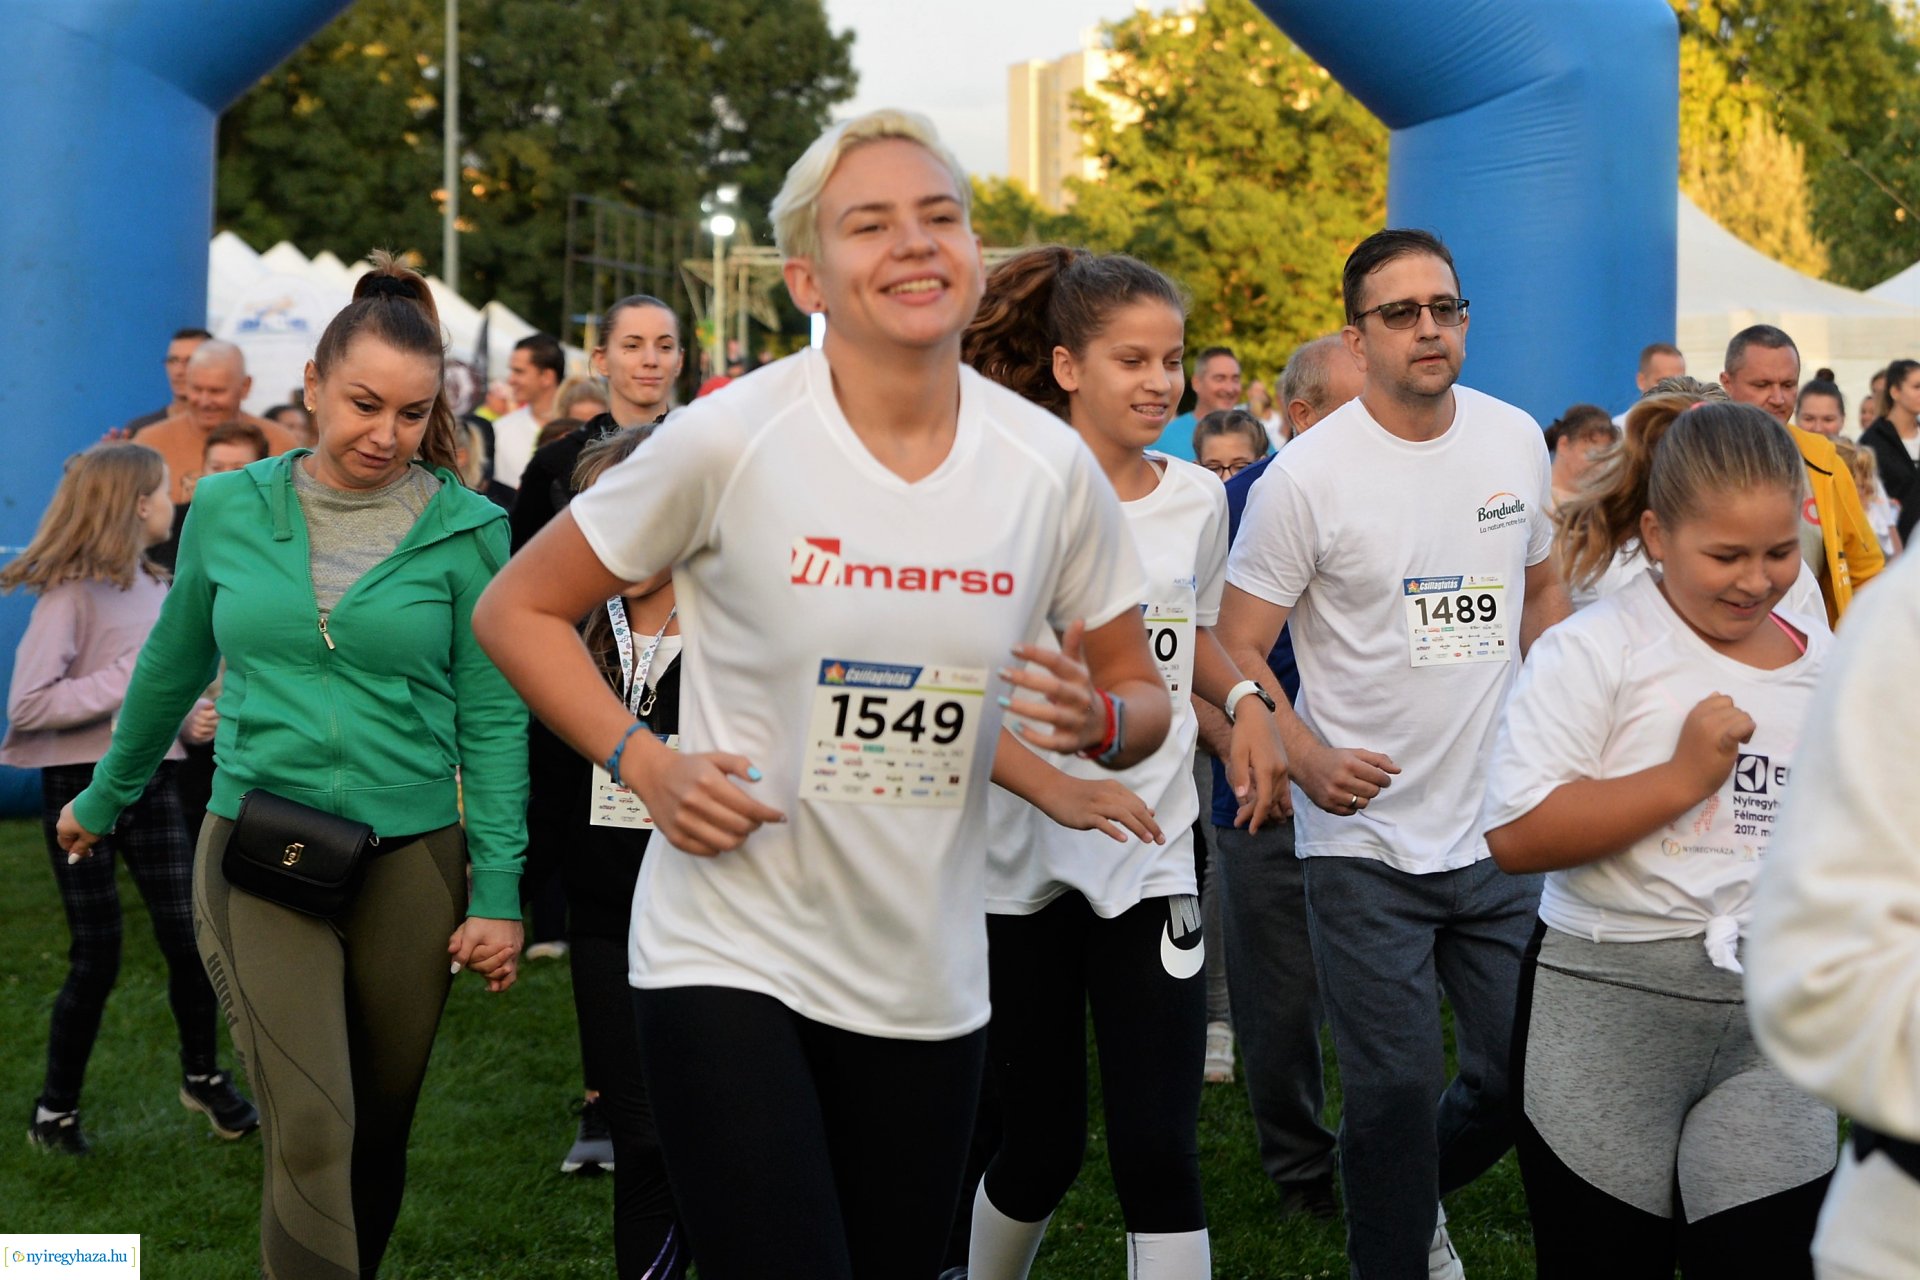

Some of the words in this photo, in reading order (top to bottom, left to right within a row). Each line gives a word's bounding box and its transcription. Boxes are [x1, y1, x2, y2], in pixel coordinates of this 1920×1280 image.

[1477, 499, 1525, 522] Bonduelle
[844, 563, 1014, 596] marso
[1415, 593, 1497, 626] 1489
[832, 693, 965, 745] 1549
[1734, 824, 1757, 836] 2017.
